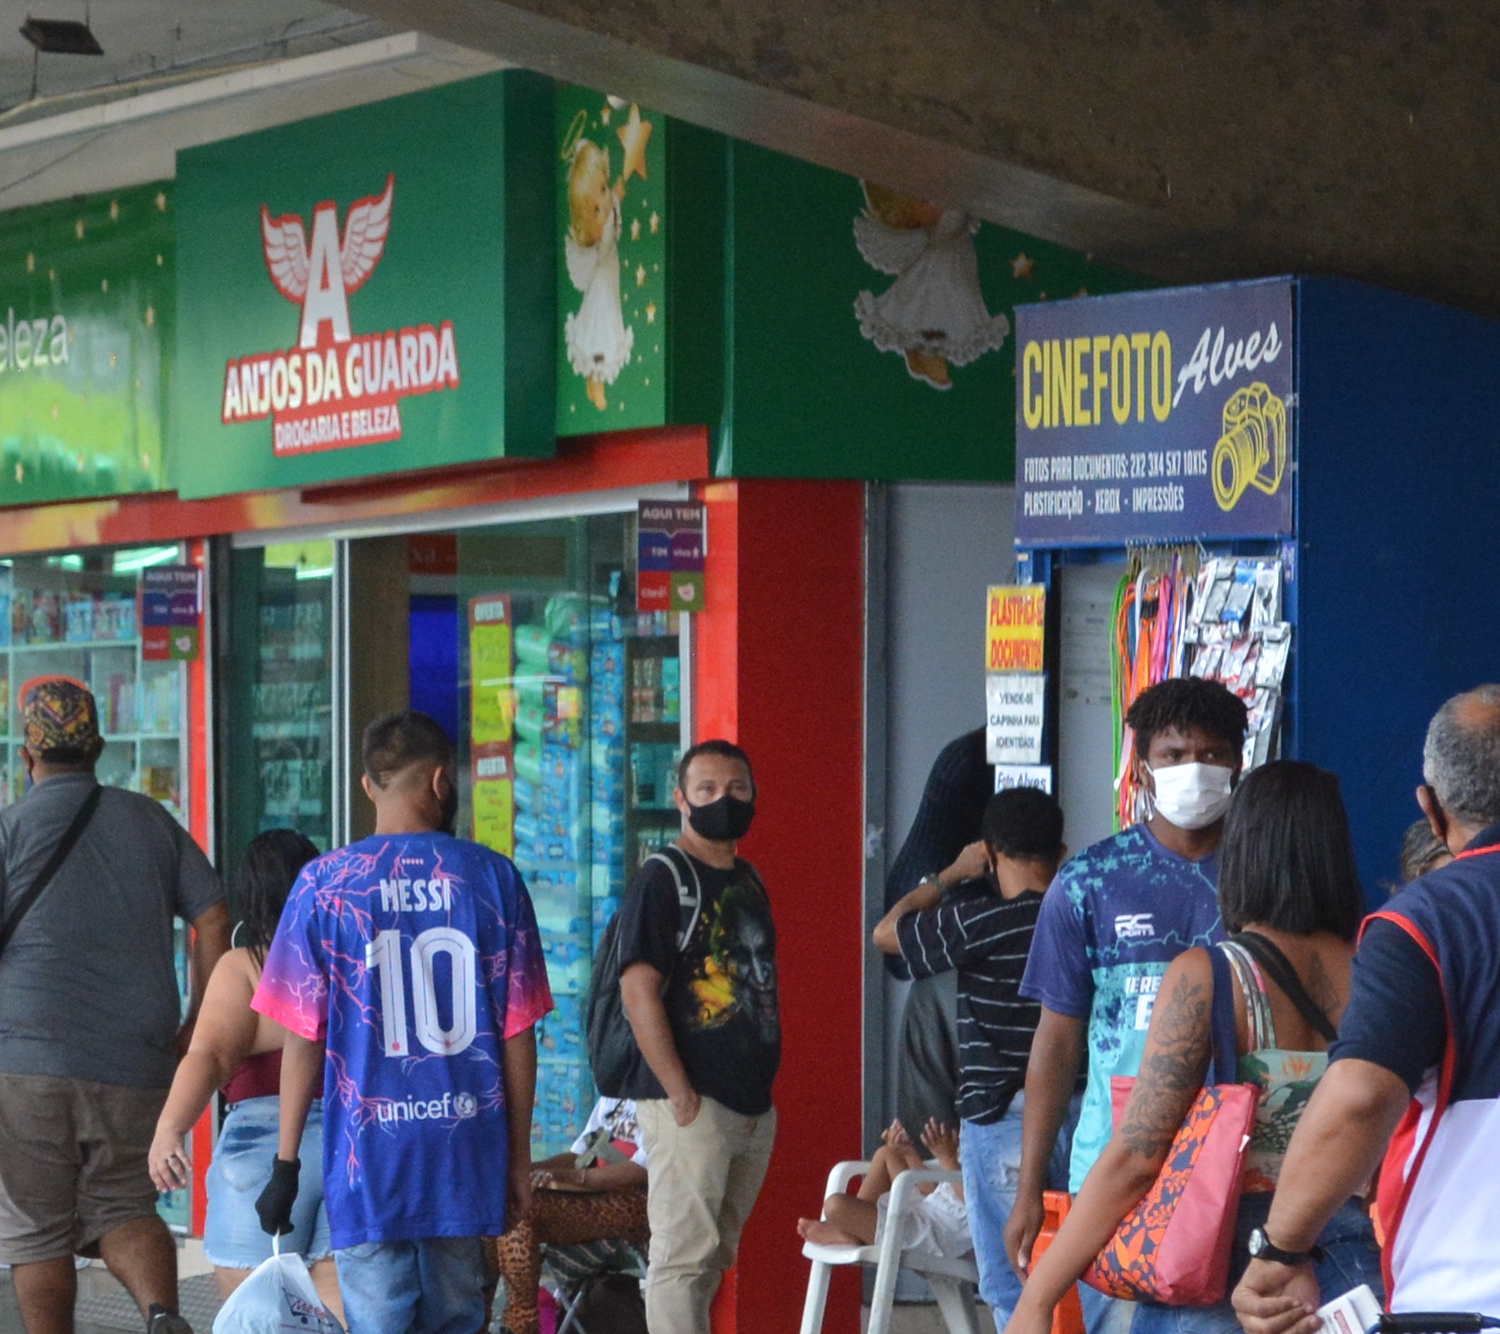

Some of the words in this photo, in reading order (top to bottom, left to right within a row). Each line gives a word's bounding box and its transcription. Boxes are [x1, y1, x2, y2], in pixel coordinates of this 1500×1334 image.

[223, 354, 303, 418] ANJOS
[306, 348, 342, 405] DA
[345, 327, 458, 397] GUARDA
[1023, 330, 1172, 430] CINEFOTO
[1173, 321, 1282, 408] Alves
[275, 414, 341, 449] DROGARIA
[343, 414, 350, 438] E
[351, 405, 400, 437] BELEZA
[1024, 457, 1049, 482] FOTOS
[1051, 456, 1072, 481] PARA
[1130, 453, 1146, 478] 2X2
[1148, 451, 1164, 478] 3X4
[1166, 450, 1181, 477] 5X7
[1183, 449, 1207, 476] 10X15
[642, 507, 672, 520] AQUI
[675, 507, 701, 521] TEM
[1024, 486, 1083, 520] PLASTIFICAÇÃO
[1094, 488, 1120, 514] XEROX
[1132, 481, 1184, 512] IMPRESSÕES
[990, 714, 1023, 726] CAPINHA
[381, 878, 452, 913] MESSI
[365, 927, 478, 1058] 10
[377, 1092, 452, 1123] unicef
